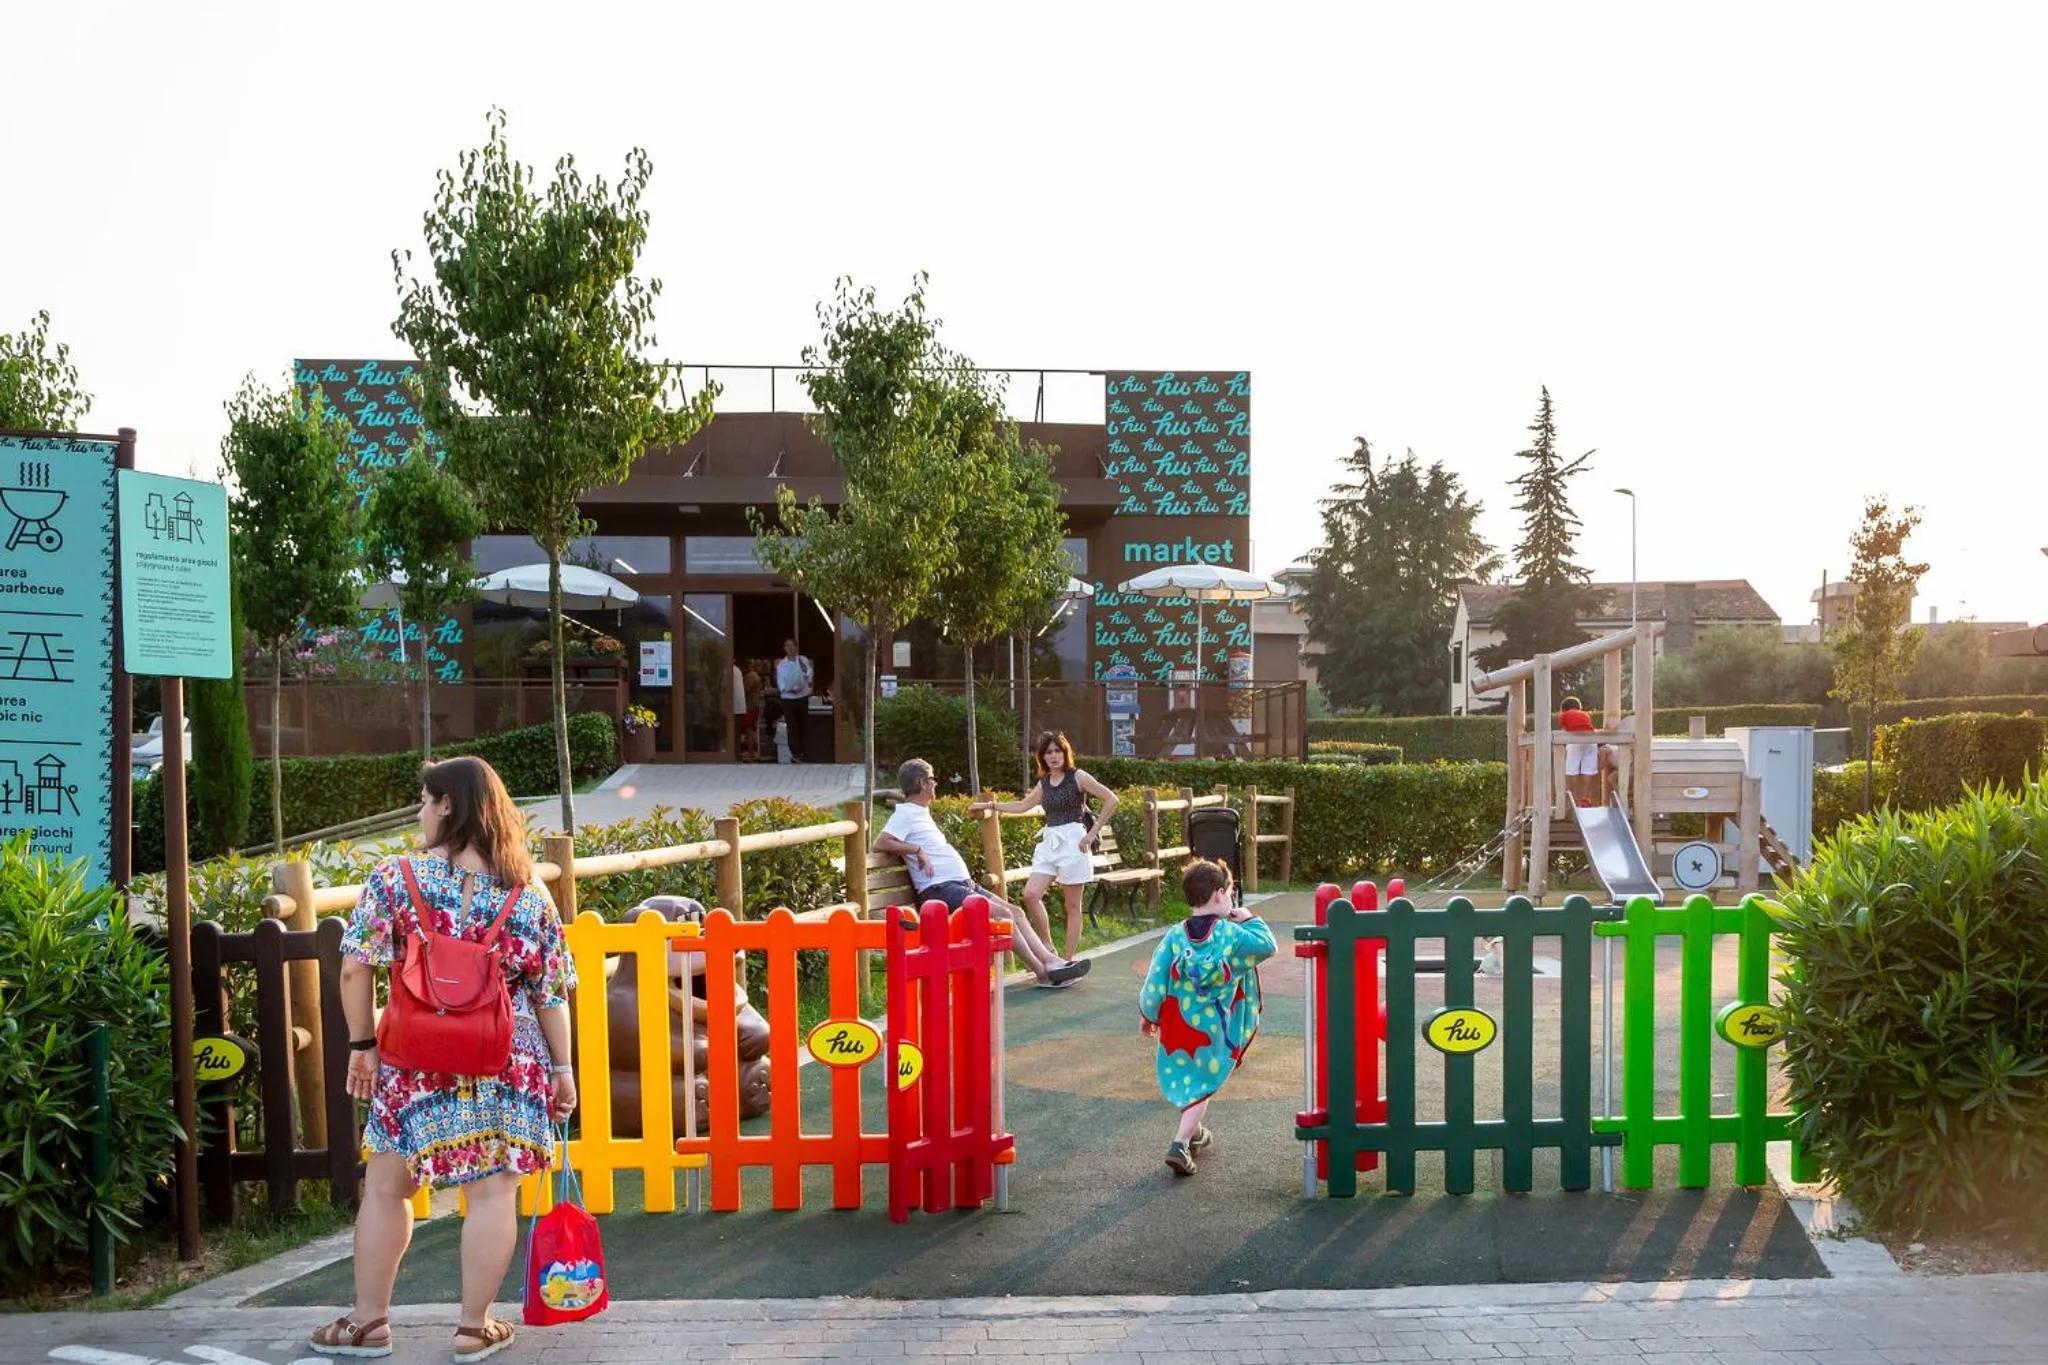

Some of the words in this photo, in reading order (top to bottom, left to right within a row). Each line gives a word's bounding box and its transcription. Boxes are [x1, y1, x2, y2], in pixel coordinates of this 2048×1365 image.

[320, 364, 349, 382] hu
[353, 361, 395, 385] hu
[1120, 376, 1147, 392] hu
[1152, 372, 1191, 396] hu
[1192, 376, 1219, 393] hu
[342, 387, 367, 402] hu
[383, 390, 407, 405] hu
[1108, 400, 1130, 414] hu
[1142, 398, 1164, 412] hu
[1180, 400, 1202, 414] hu
[1213, 398, 1236, 413] hu
[354, 402, 395, 427] hu
[397, 407, 425, 425] hu
[1120, 416, 1147, 433] hu
[1152, 411, 1191, 436] hu
[1192, 416, 1219, 434] hu
[384, 431, 407, 446] hu
[1108, 439, 1130, 454] hu
[1142, 438, 1164, 453] hu
[1180, 440, 1202, 454] hu
[1213, 439, 1236, 454] hu
[1120, 456, 1147, 473] hu
[1152, 451, 1191, 476] hu
[1192, 456, 1219, 473] hu
[1119, 481, 1130, 494] u
[1142, 478, 1164, 492] hu
[1180, 480, 1202, 494] hu
[1213, 478, 1236, 493] hu
[1120, 495, 1147, 512] hu
[1152, 491, 1191, 515] hu
[1192, 496, 1219, 513] hu
[1124, 535, 1234, 563] market
[1109, 611, 1131, 625] hu
[1142, 609, 1164, 623] hu
[1214, 609, 1237, 623] hu
[358, 618, 399, 643] hu
[1121, 626, 1147, 643] hu
[1153, 622, 1191, 646] hu
[1108, 651, 1130, 665] hu
[1141, 648, 1164, 663] hu
[22, 711, 43, 723] nic
[31, 826, 73, 839] giochi
[1444, 1018, 1481, 1042] hu
[1740, 1013, 1776, 1036] hu
[192, 1046, 230, 1069] hu
[826, 1030, 864, 1054] hu
[899, 1053, 913, 1076] u
